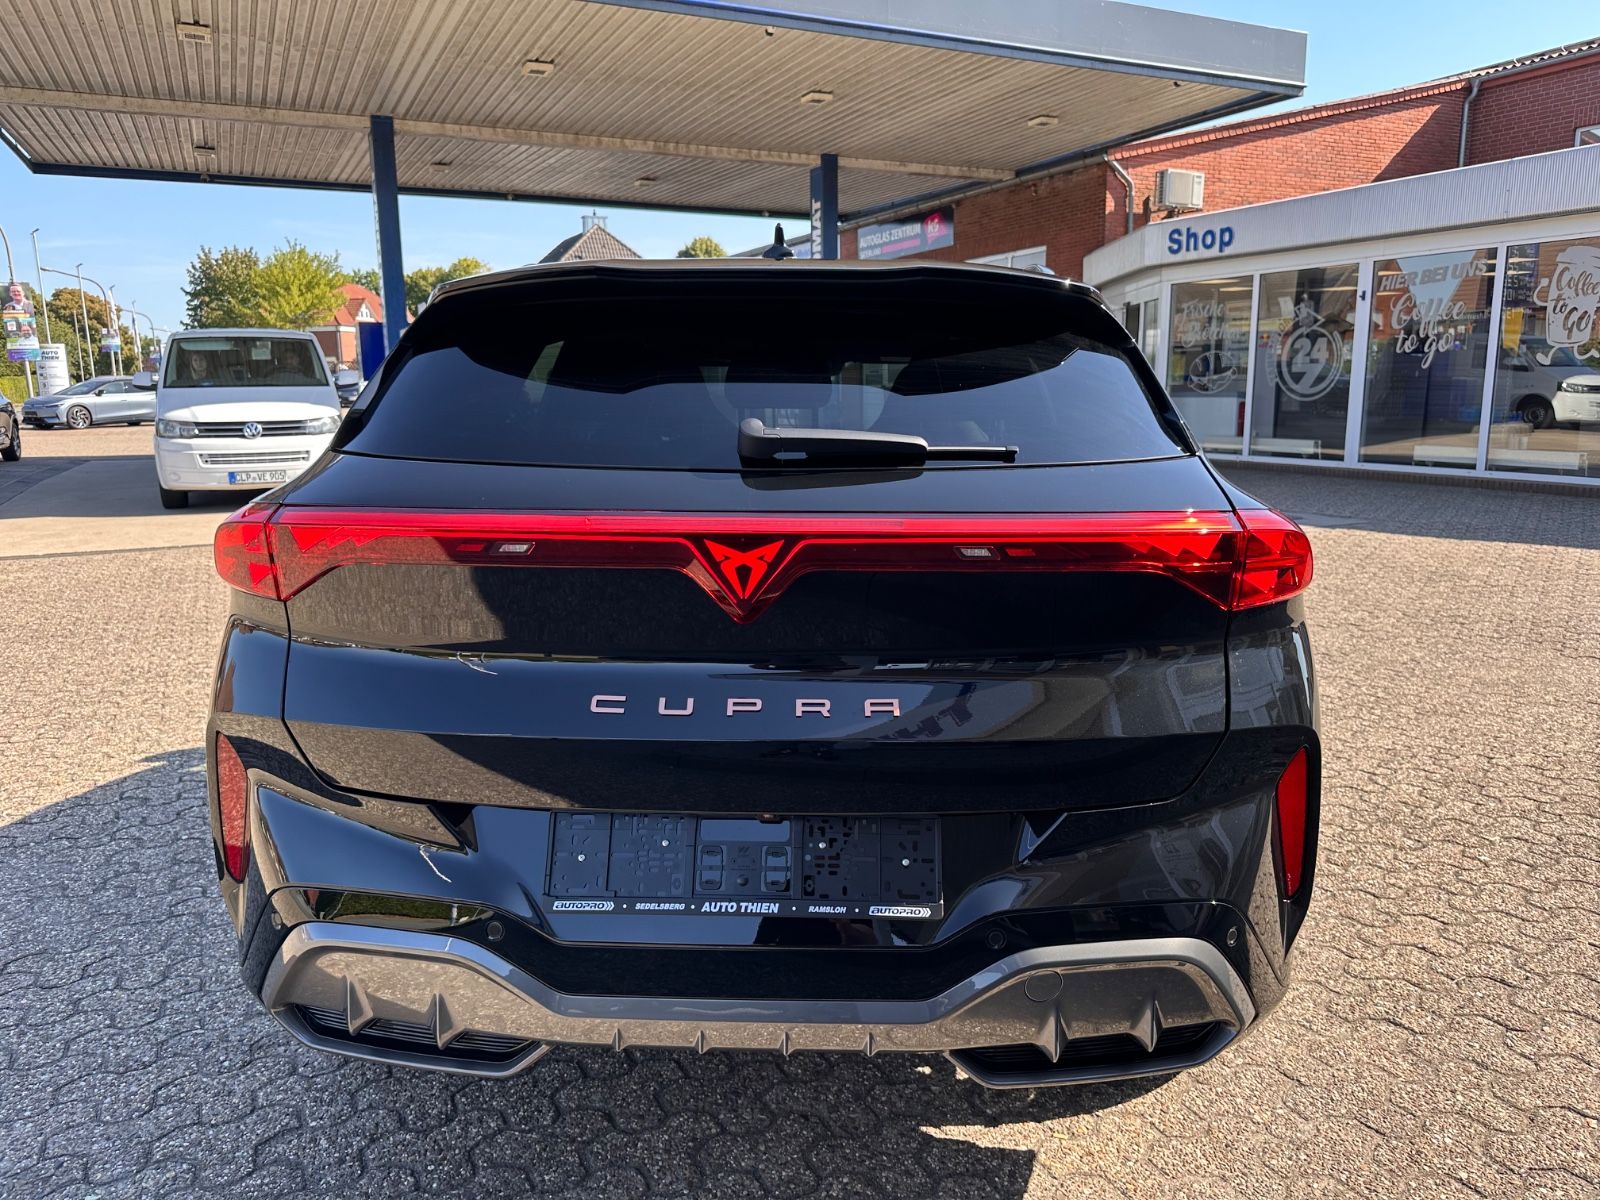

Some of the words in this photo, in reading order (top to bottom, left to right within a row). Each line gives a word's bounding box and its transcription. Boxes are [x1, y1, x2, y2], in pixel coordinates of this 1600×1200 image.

[860, 230, 890, 249] AUTOGLAS
[891, 222, 922, 241] ZENTRUM
[1167, 225, 1235, 254] Shop
[1379, 271, 1417, 291] HIER
[1419, 265, 1449, 284] BEI
[1451, 258, 1488, 279] UNS
[1556, 266, 1600, 297] Coffee
[1390, 293, 1466, 338] Coffee
[1550, 292, 1568, 315] to
[1291, 336, 1329, 373] 24
[1395, 331, 1419, 354] to
[257, 472, 269, 481] VE
[590, 694, 901, 718] CUPRA
[635, 902, 686, 911] SEDELSBERG
[701, 901, 738, 913] AUTO
[740, 902, 780, 914] THIEN
[808, 905, 848, 914] RAMSLOH
